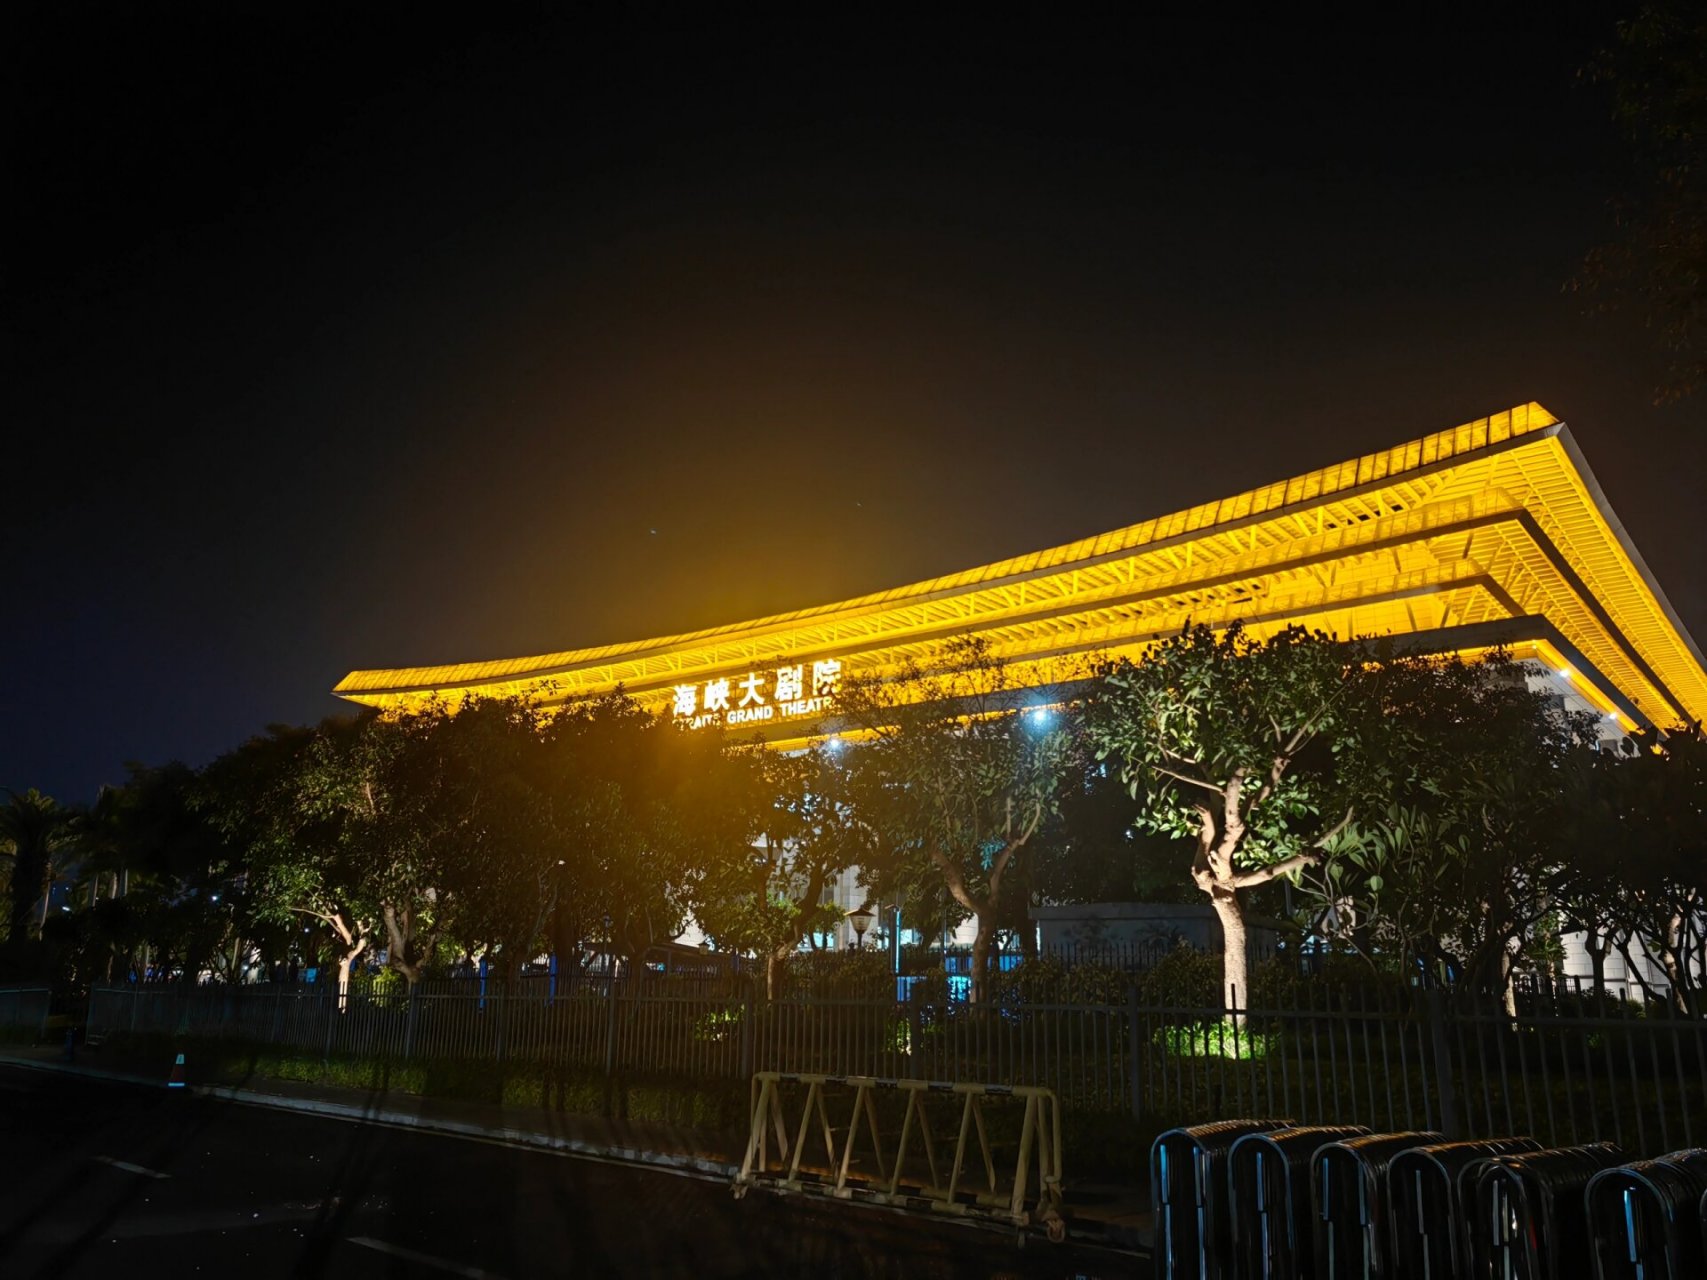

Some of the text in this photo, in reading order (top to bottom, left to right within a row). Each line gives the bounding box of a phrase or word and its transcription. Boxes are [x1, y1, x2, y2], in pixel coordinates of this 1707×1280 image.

[672, 658, 842, 717] 海峡大剧院
[727, 705, 773, 724] GRAND
[779, 696, 842, 717] THEATR
